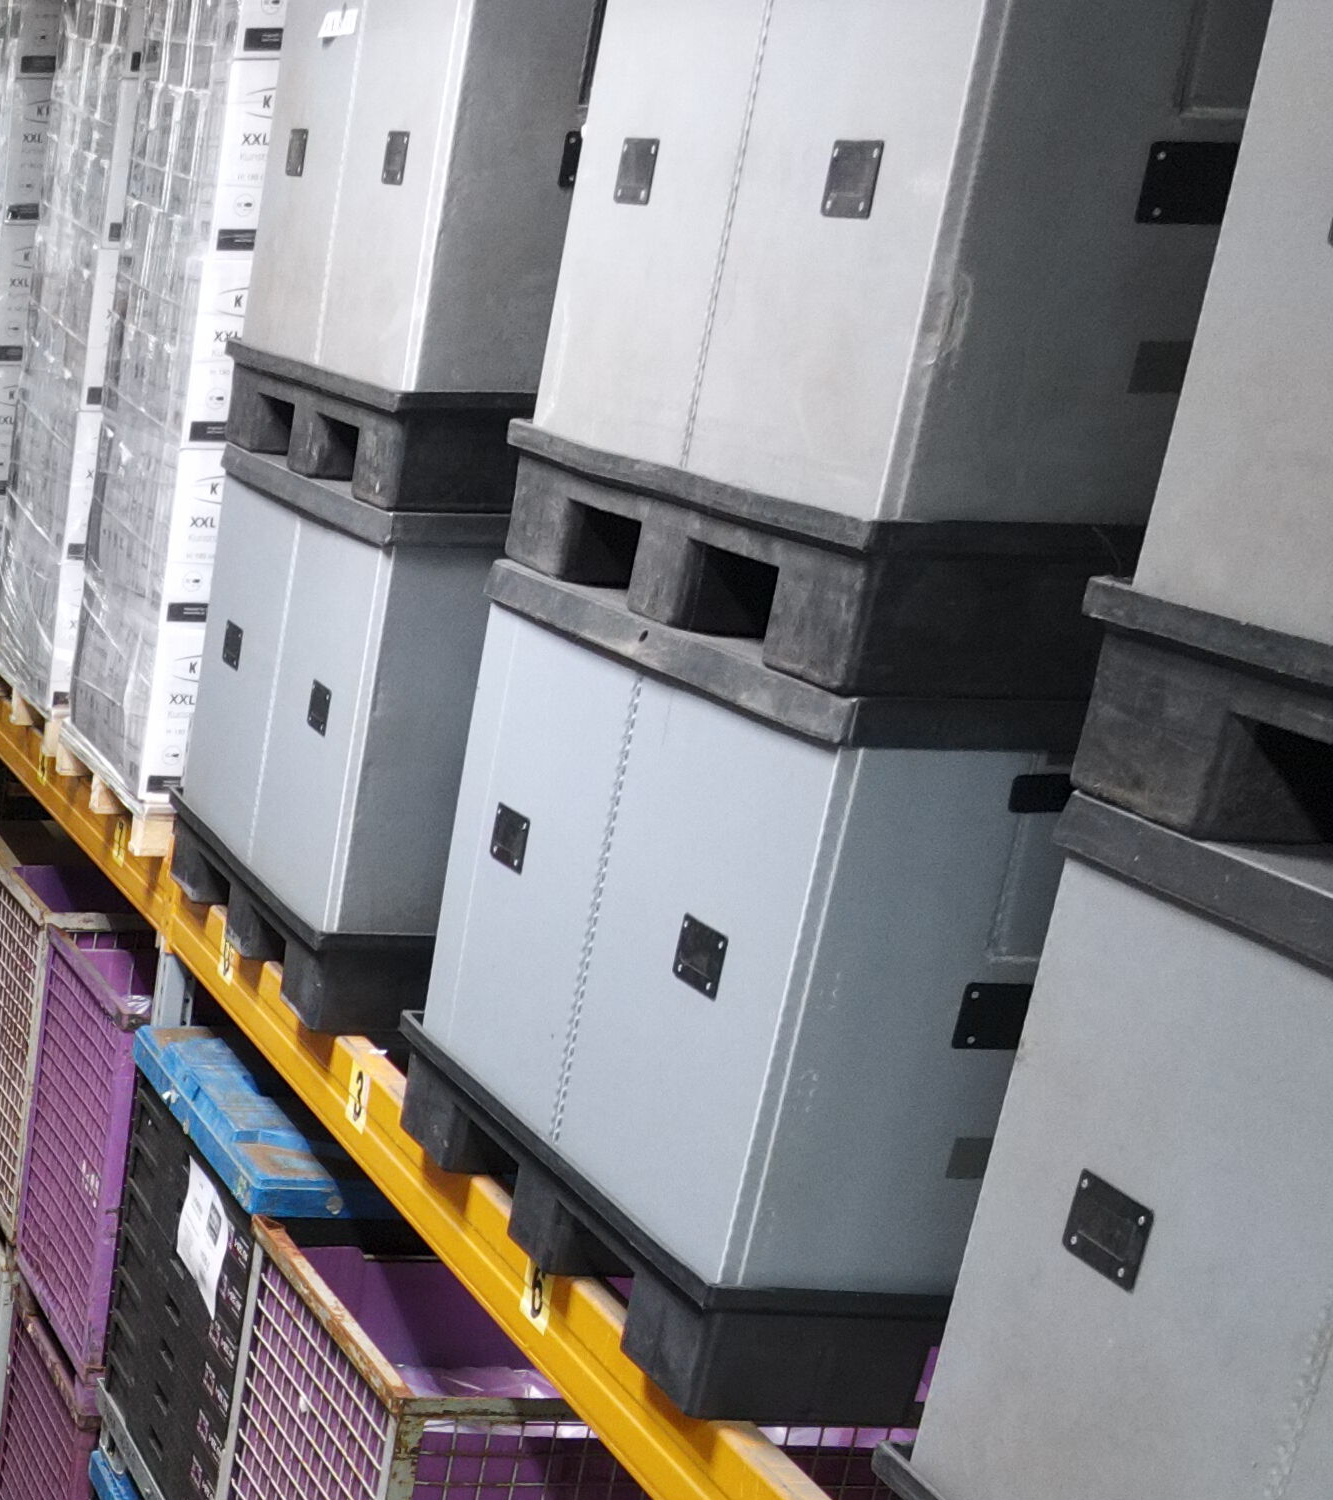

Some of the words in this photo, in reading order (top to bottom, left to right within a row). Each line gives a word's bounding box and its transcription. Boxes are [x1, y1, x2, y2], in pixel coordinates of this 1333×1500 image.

[241, 132, 271, 146] XXL
[189, 516, 217, 528] XXL
[168, 693, 196, 705] XXL
[354, 1070, 364, 1122] 3
